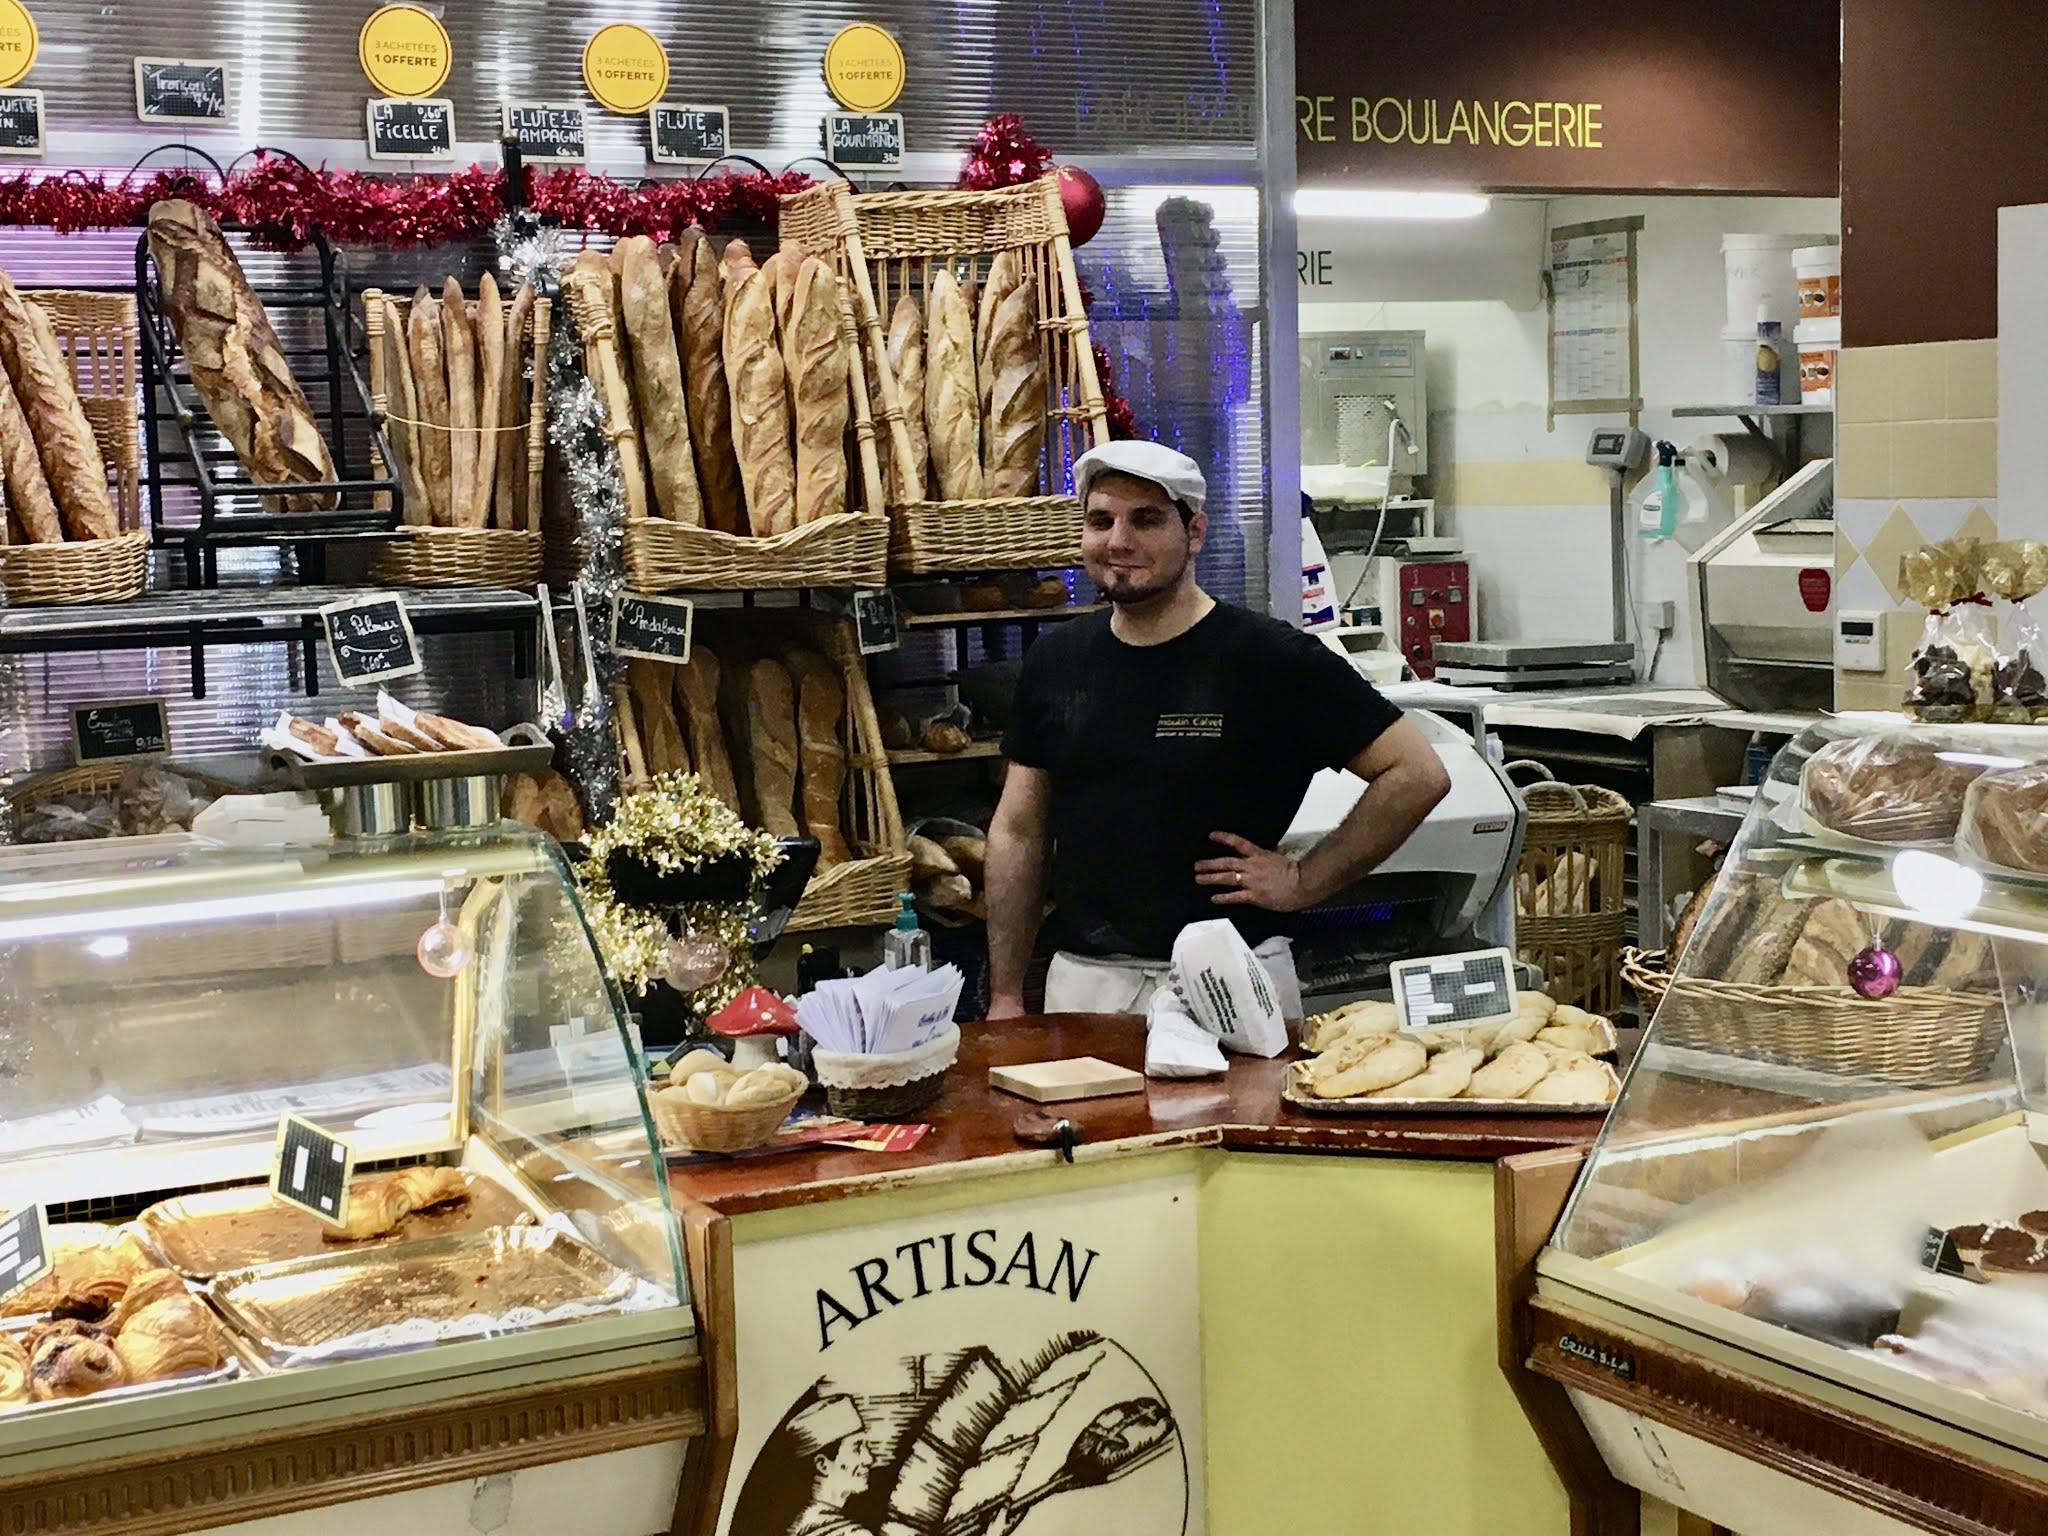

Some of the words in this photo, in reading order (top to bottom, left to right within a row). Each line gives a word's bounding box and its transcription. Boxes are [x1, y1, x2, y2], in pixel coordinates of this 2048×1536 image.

[375, 40, 381, 49] 3
[383, 40, 437, 53] ACHETÉES
[375, 54, 380, 63] 1
[383, 54, 437, 67] OFFERTE
[604, 57, 655, 68] ACHETÉES
[597, 69, 602, 78] 1
[605, 70, 655, 82] OFFERTE
[839, 72, 844, 80] 1
[846, 71, 893, 80] OFFERTE
[374, 105, 394, 120] LA
[510, 108, 559, 128] FLUTE
[657, 111, 706, 130] FLUTE
[832, 118, 851, 133] LA
[1352, 97, 1602, 148] BOULANGERIE
[832, 134, 900, 148] GOURMANDE
[818, 1229, 1100, 1352] ARTISAN
